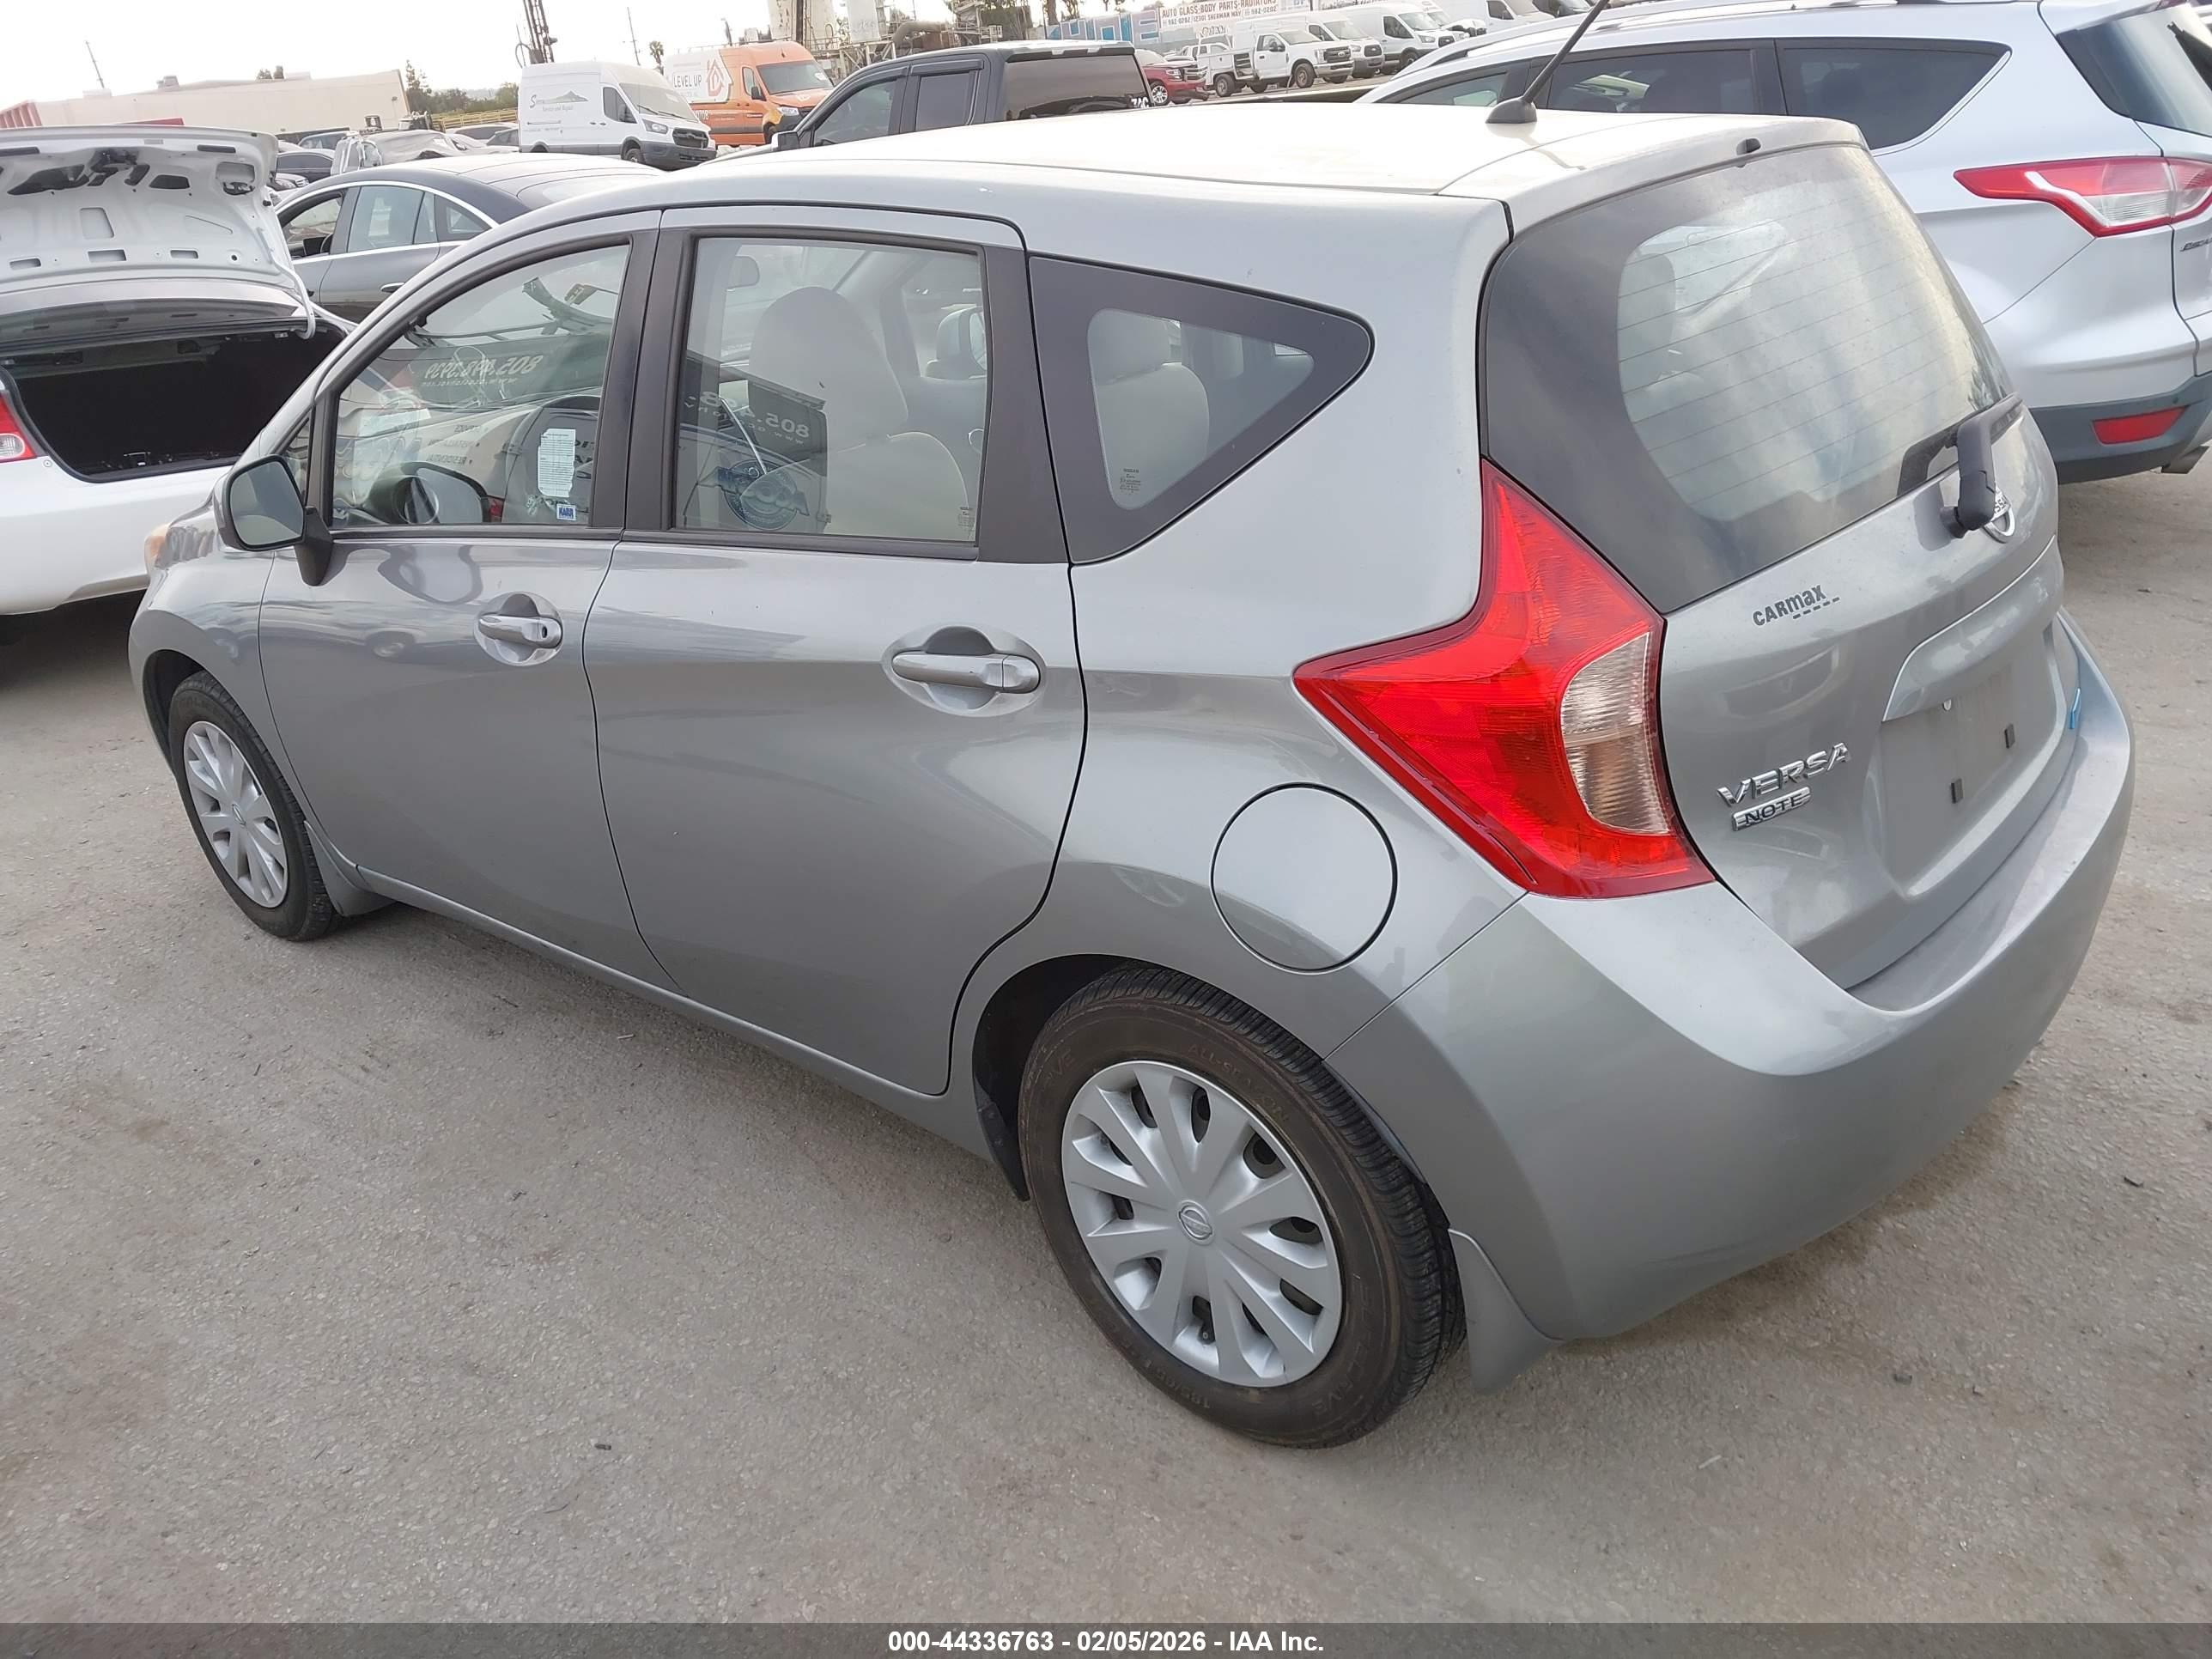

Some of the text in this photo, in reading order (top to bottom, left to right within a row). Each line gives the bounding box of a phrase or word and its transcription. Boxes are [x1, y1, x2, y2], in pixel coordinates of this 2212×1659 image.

[1162, 8, 1177, 18] AUTO
[1207, 12, 1231, 21] SHERMAN
[673, 75, 702, 88] LEVEL UP
[1717, 742, 1852, 808] VERSA
[1745, 792, 1803, 826] NOTE
